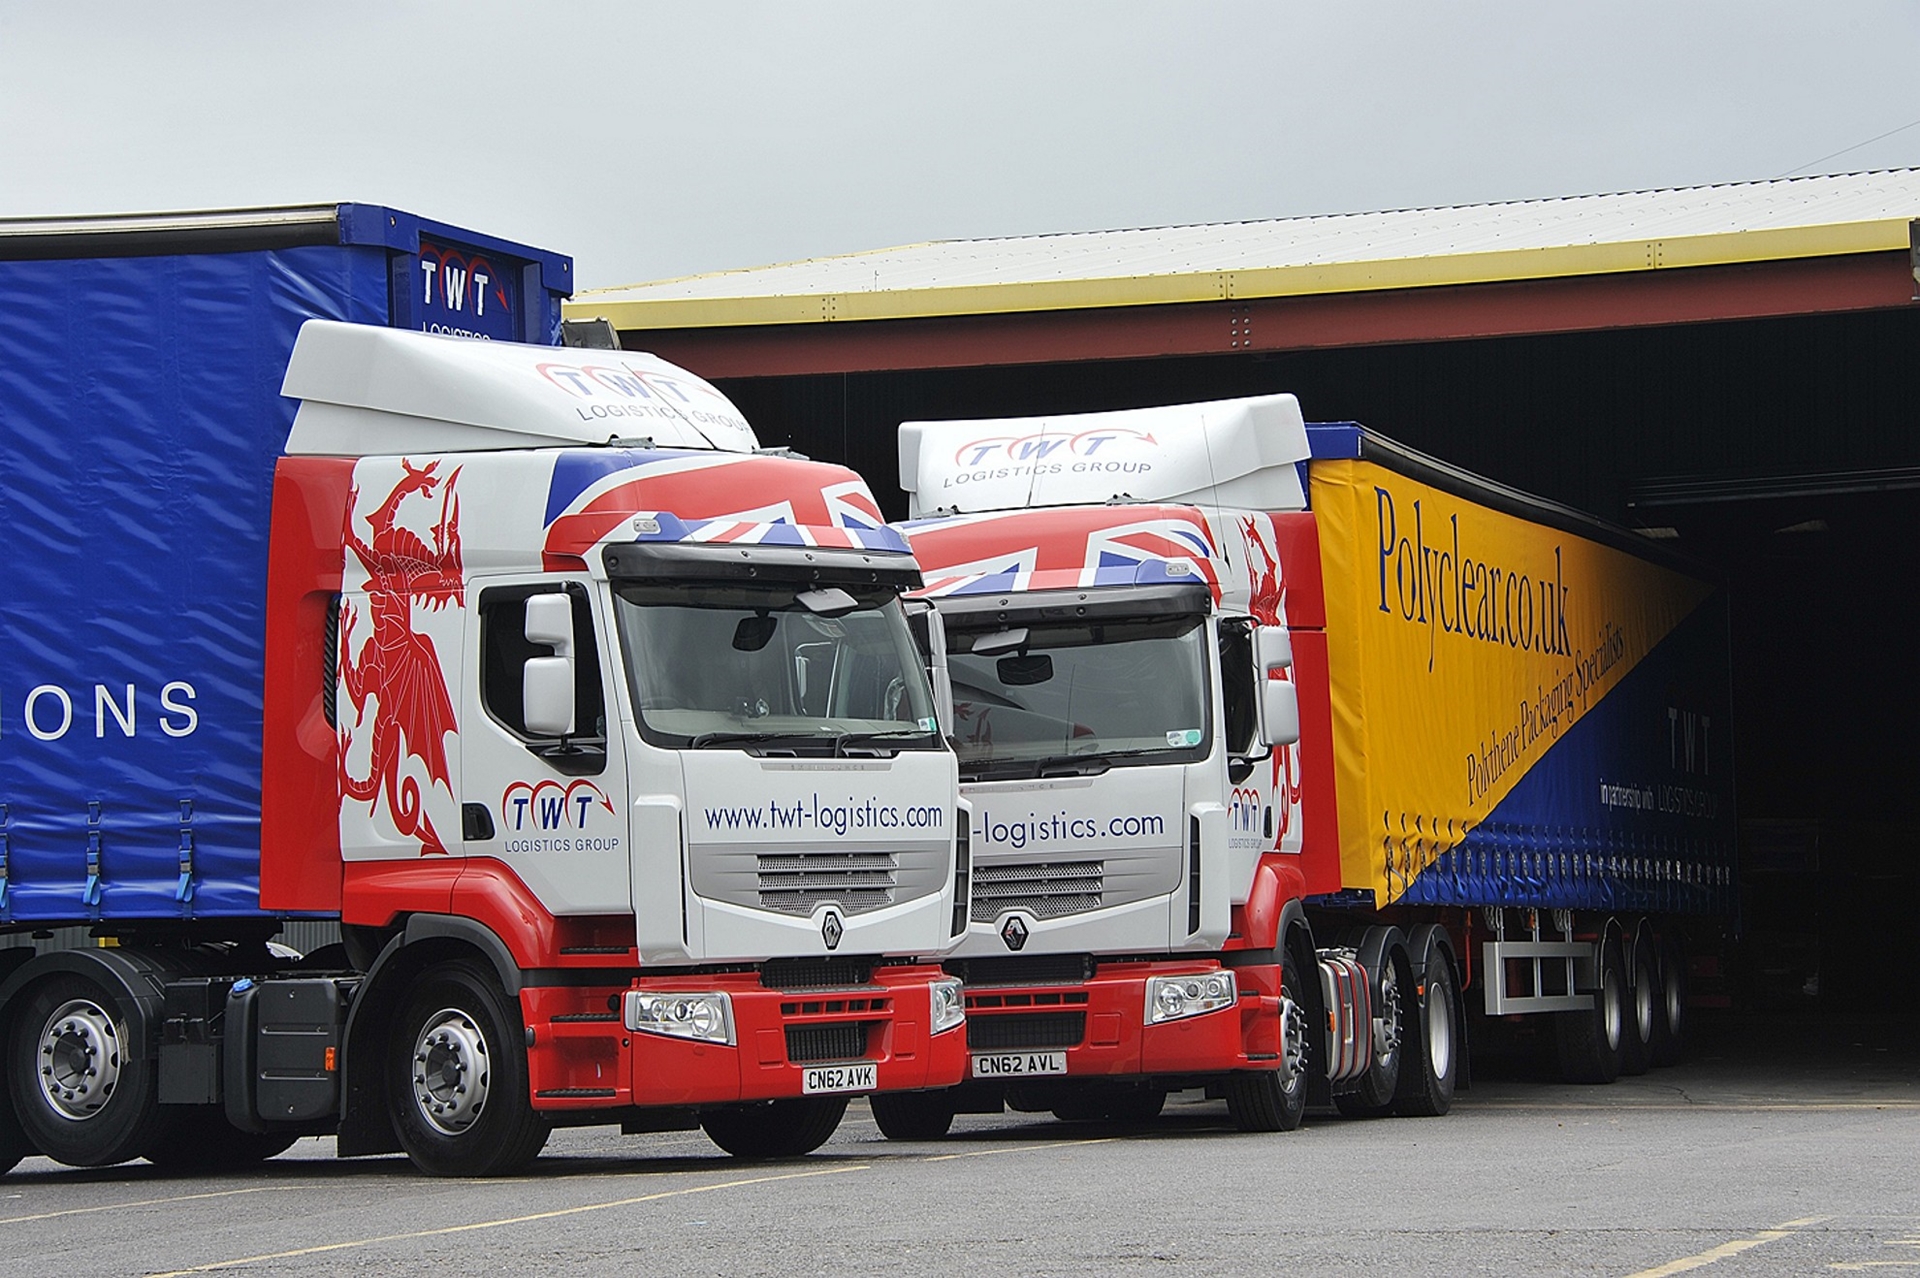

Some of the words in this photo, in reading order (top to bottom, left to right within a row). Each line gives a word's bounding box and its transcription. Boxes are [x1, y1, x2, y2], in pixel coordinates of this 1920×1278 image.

[422, 260, 488, 316] TWT
[554, 370, 691, 402] TWT
[576, 404, 688, 421] LOGISTICS
[969, 435, 1117, 466] TWT
[943, 464, 1062, 488] LOGISTICS
[1072, 461, 1152, 475] GROUP
[1373, 485, 1572, 673] Polyclear.co.uk
[0, 681, 198, 740] ONS
[1467, 729, 1519, 809] Polythene
[1520, 669, 1574, 751] Packaging
[1575, 622, 1624, 711] Specialists
[512, 796, 593, 831] TWT
[704, 792, 943, 836] www.twt-logistics.com
[504, 839, 571, 853] LOGISTICS
[574, 837, 620, 852] GROUP
[808, 1069, 844, 1090] CN62
[848, 1067, 873, 1088] AVK
[979, 1056, 1022, 1074] CN62
[1027, 1053, 1060, 1072] AVL
